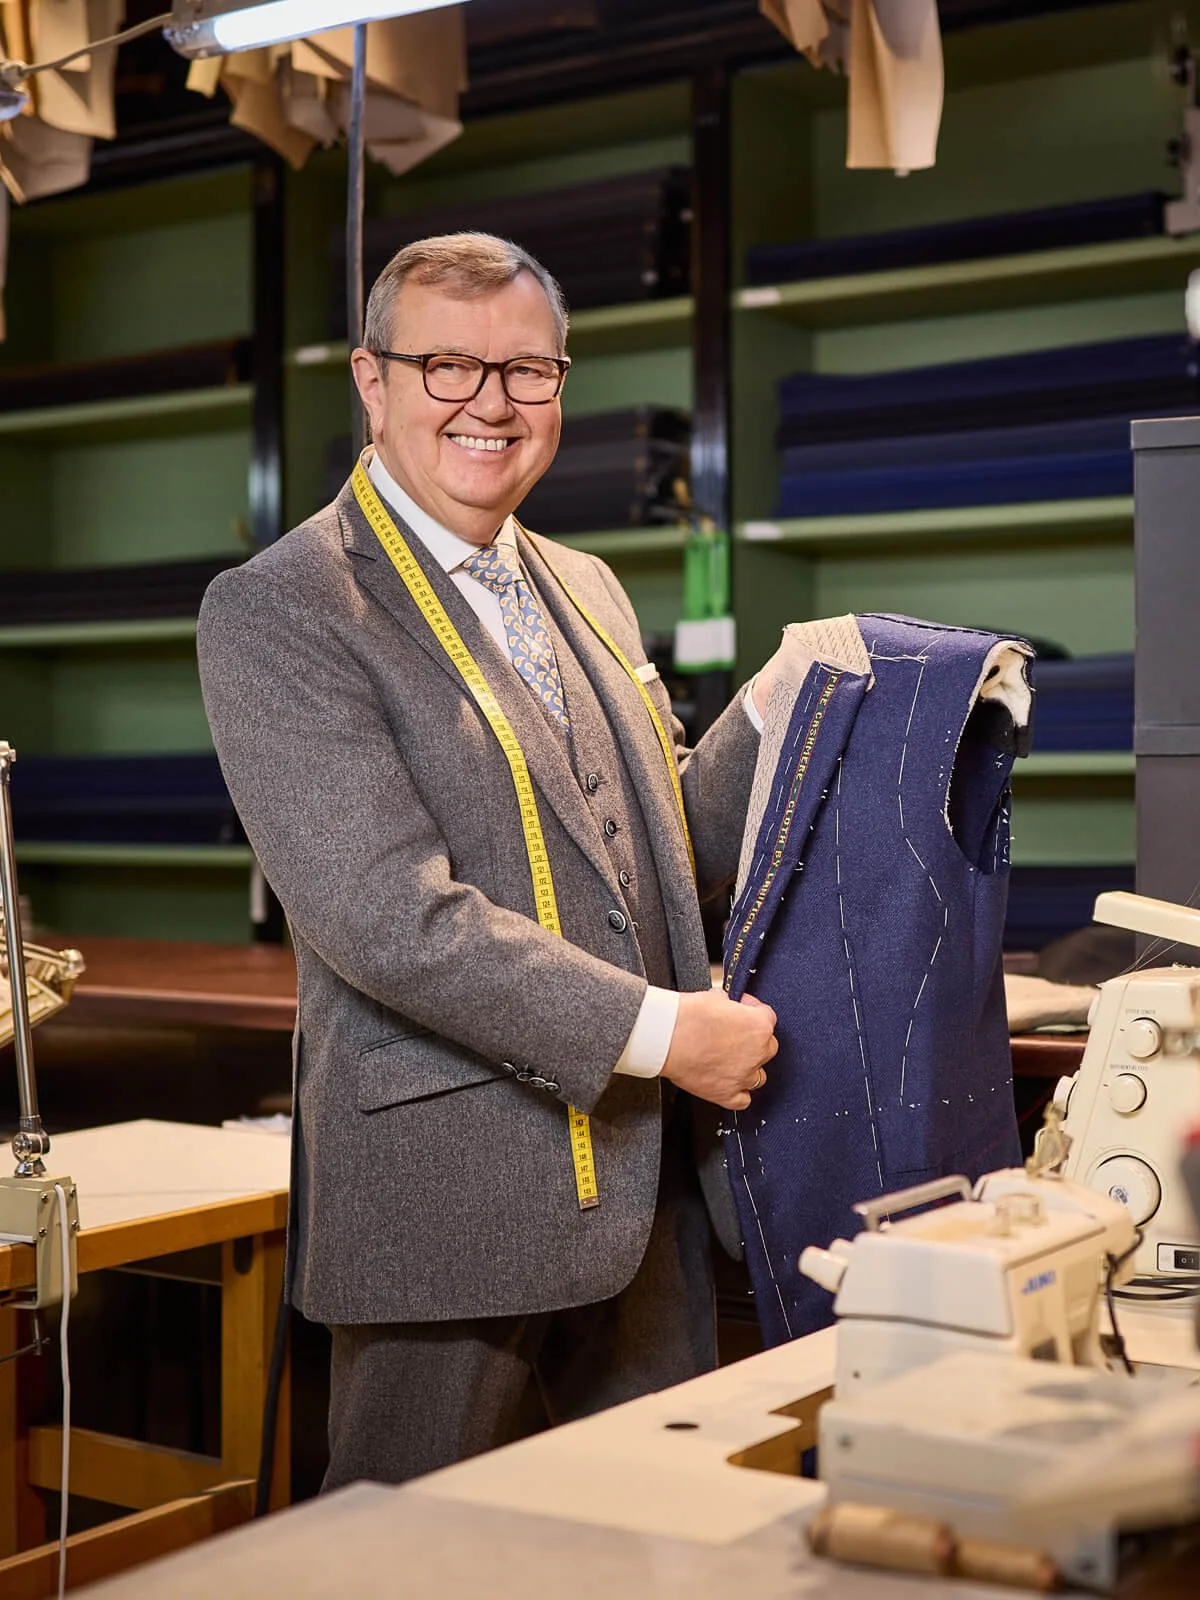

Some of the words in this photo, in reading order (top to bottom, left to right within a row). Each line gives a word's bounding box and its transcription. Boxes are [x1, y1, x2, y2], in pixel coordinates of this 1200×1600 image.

[820, 675, 838, 706] PURE
[796, 711, 823, 780] CASHMERE
[778, 800, 795, 844] CLOTH
[772, 850, 782, 867] BY
